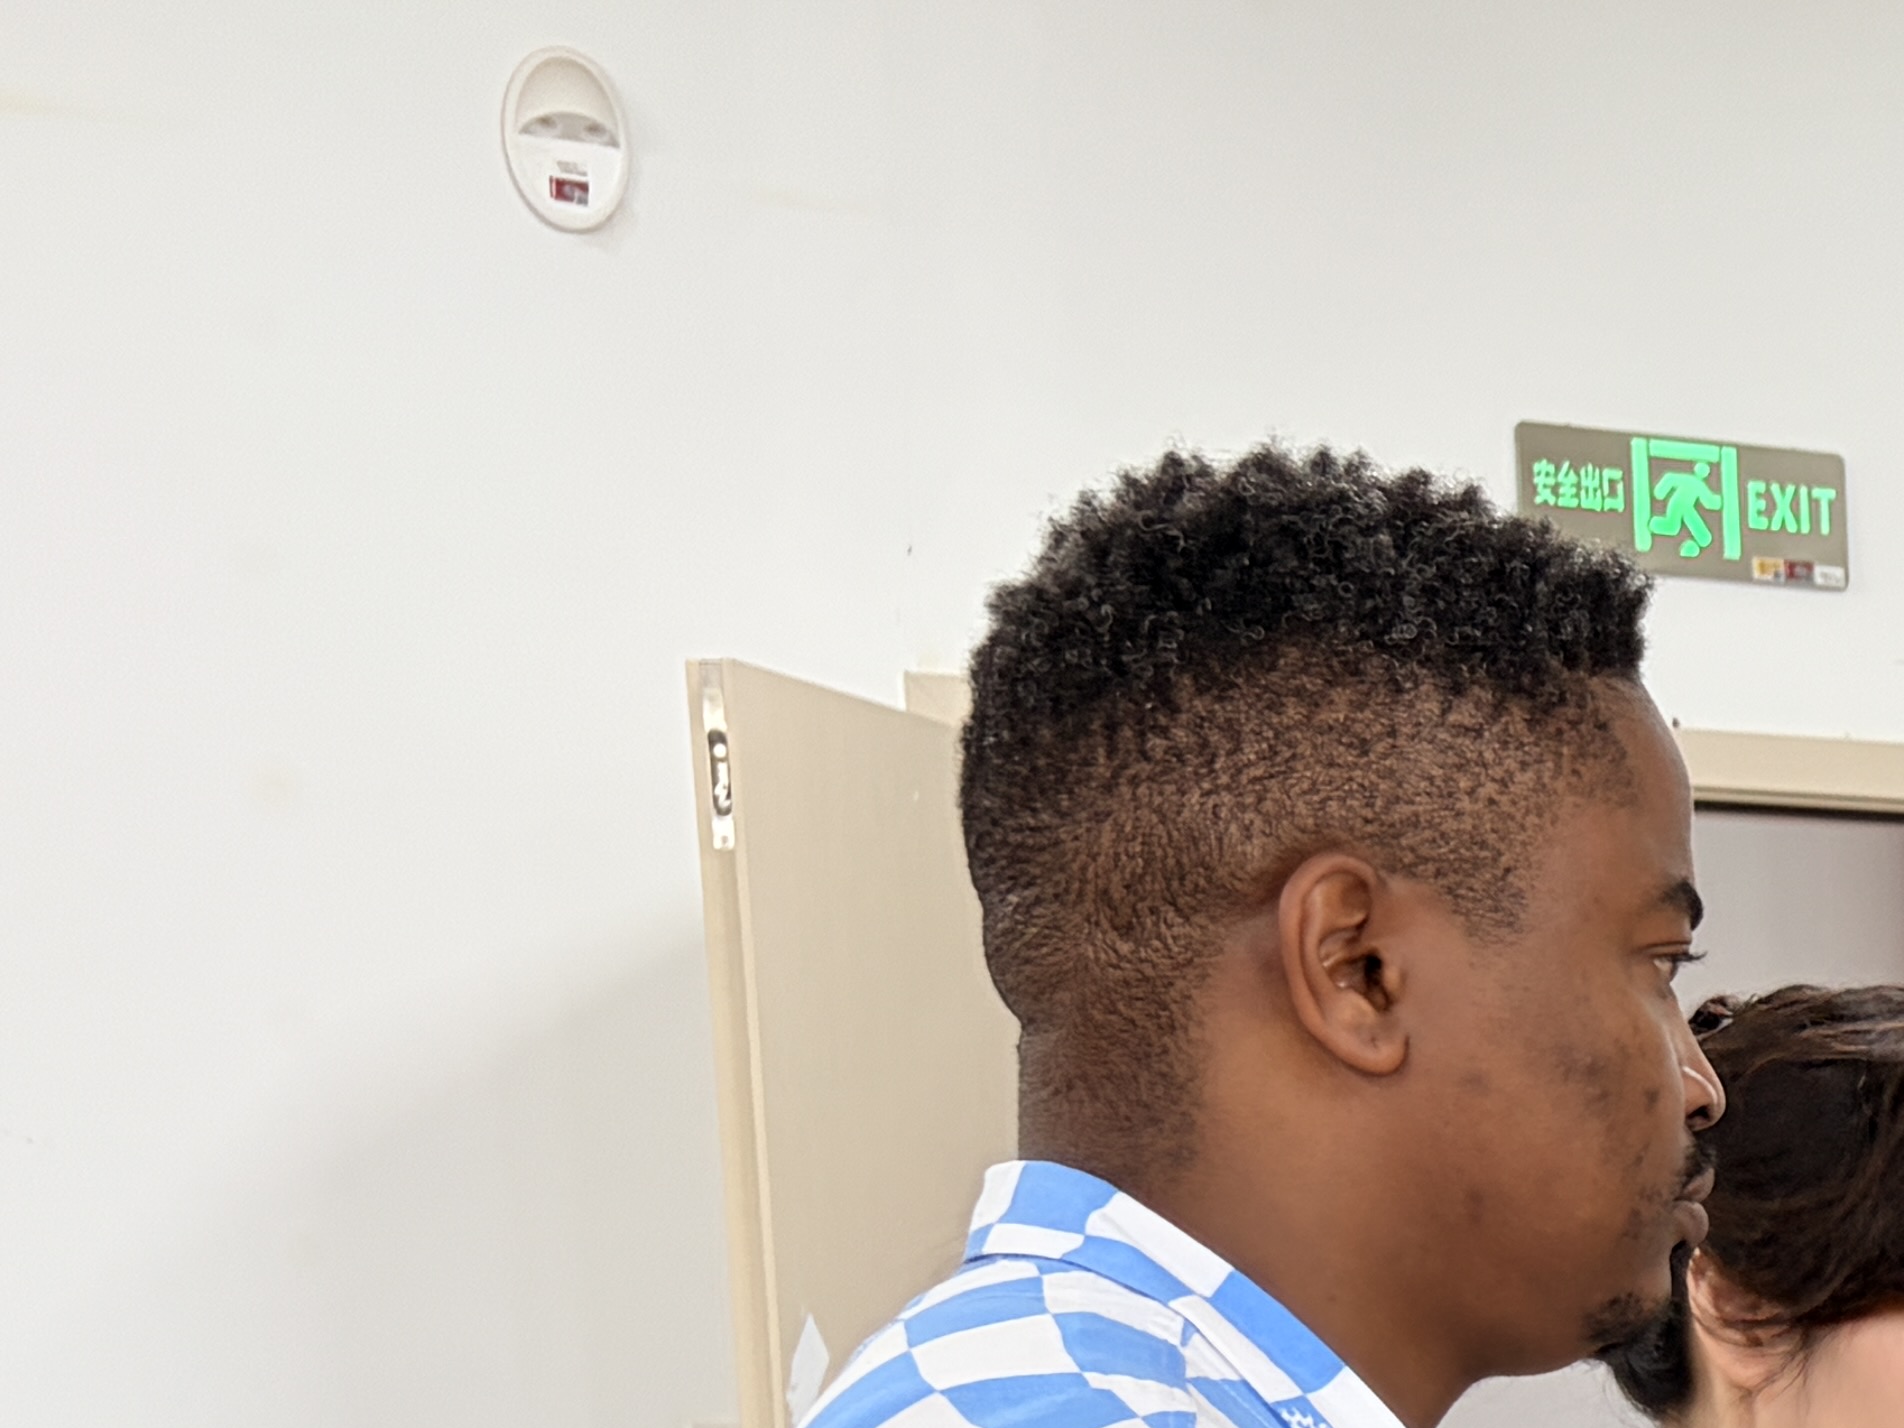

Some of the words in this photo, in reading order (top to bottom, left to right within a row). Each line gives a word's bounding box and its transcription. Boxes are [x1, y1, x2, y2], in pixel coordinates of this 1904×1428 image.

[1532, 458, 1625, 513] 安全出口
[1746, 480, 1837, 536] EXIT
